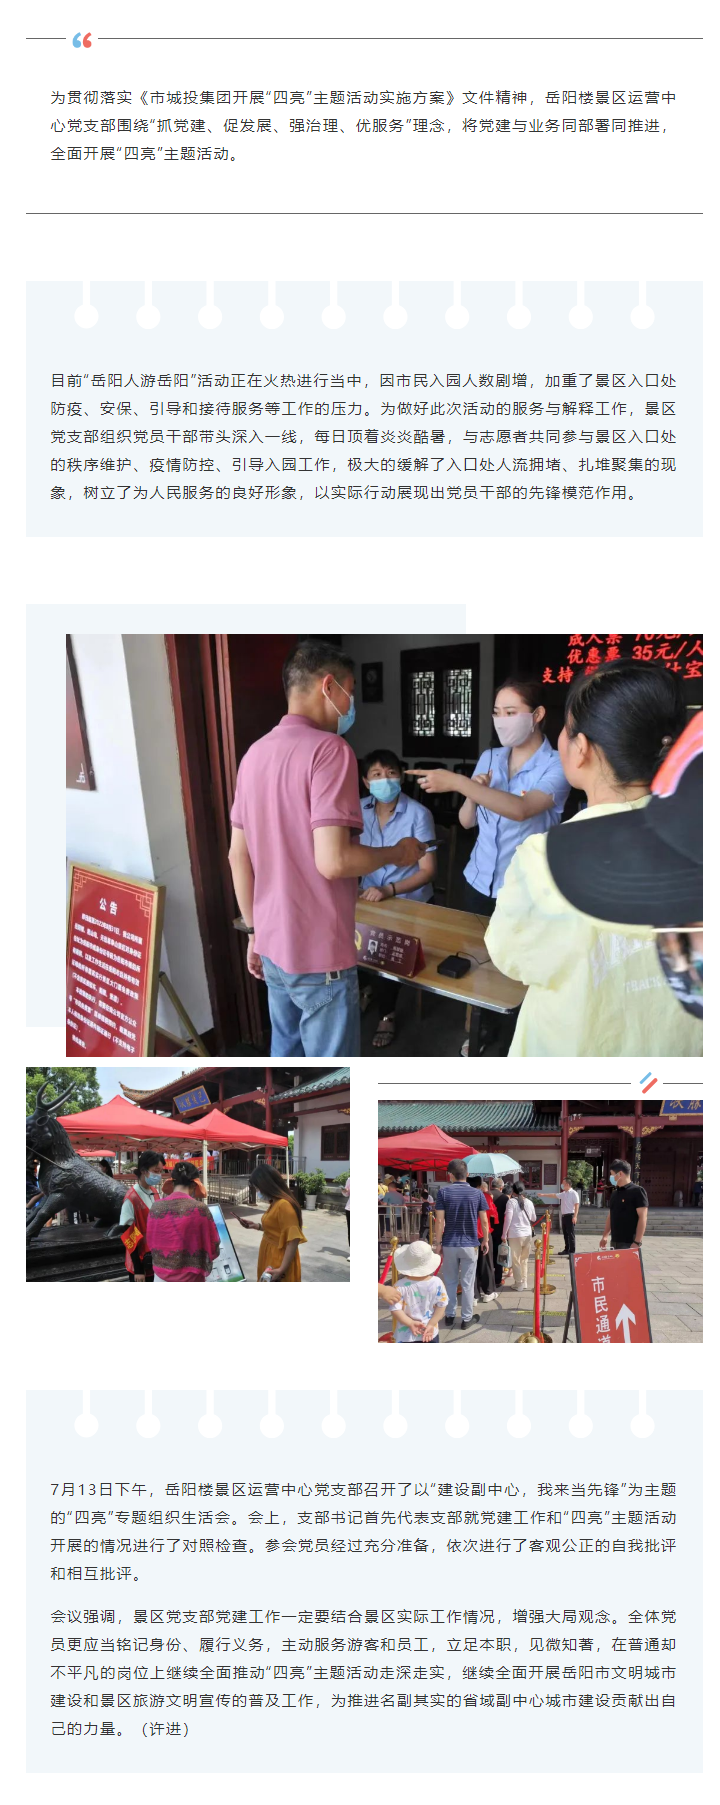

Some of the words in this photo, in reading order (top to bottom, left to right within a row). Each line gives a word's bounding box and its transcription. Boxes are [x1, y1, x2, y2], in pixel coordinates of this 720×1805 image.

[567, 646, 621, 664] 优惠票
[542, 666, 574, 683] 支持
[99, 897, 118, 915] 公告
